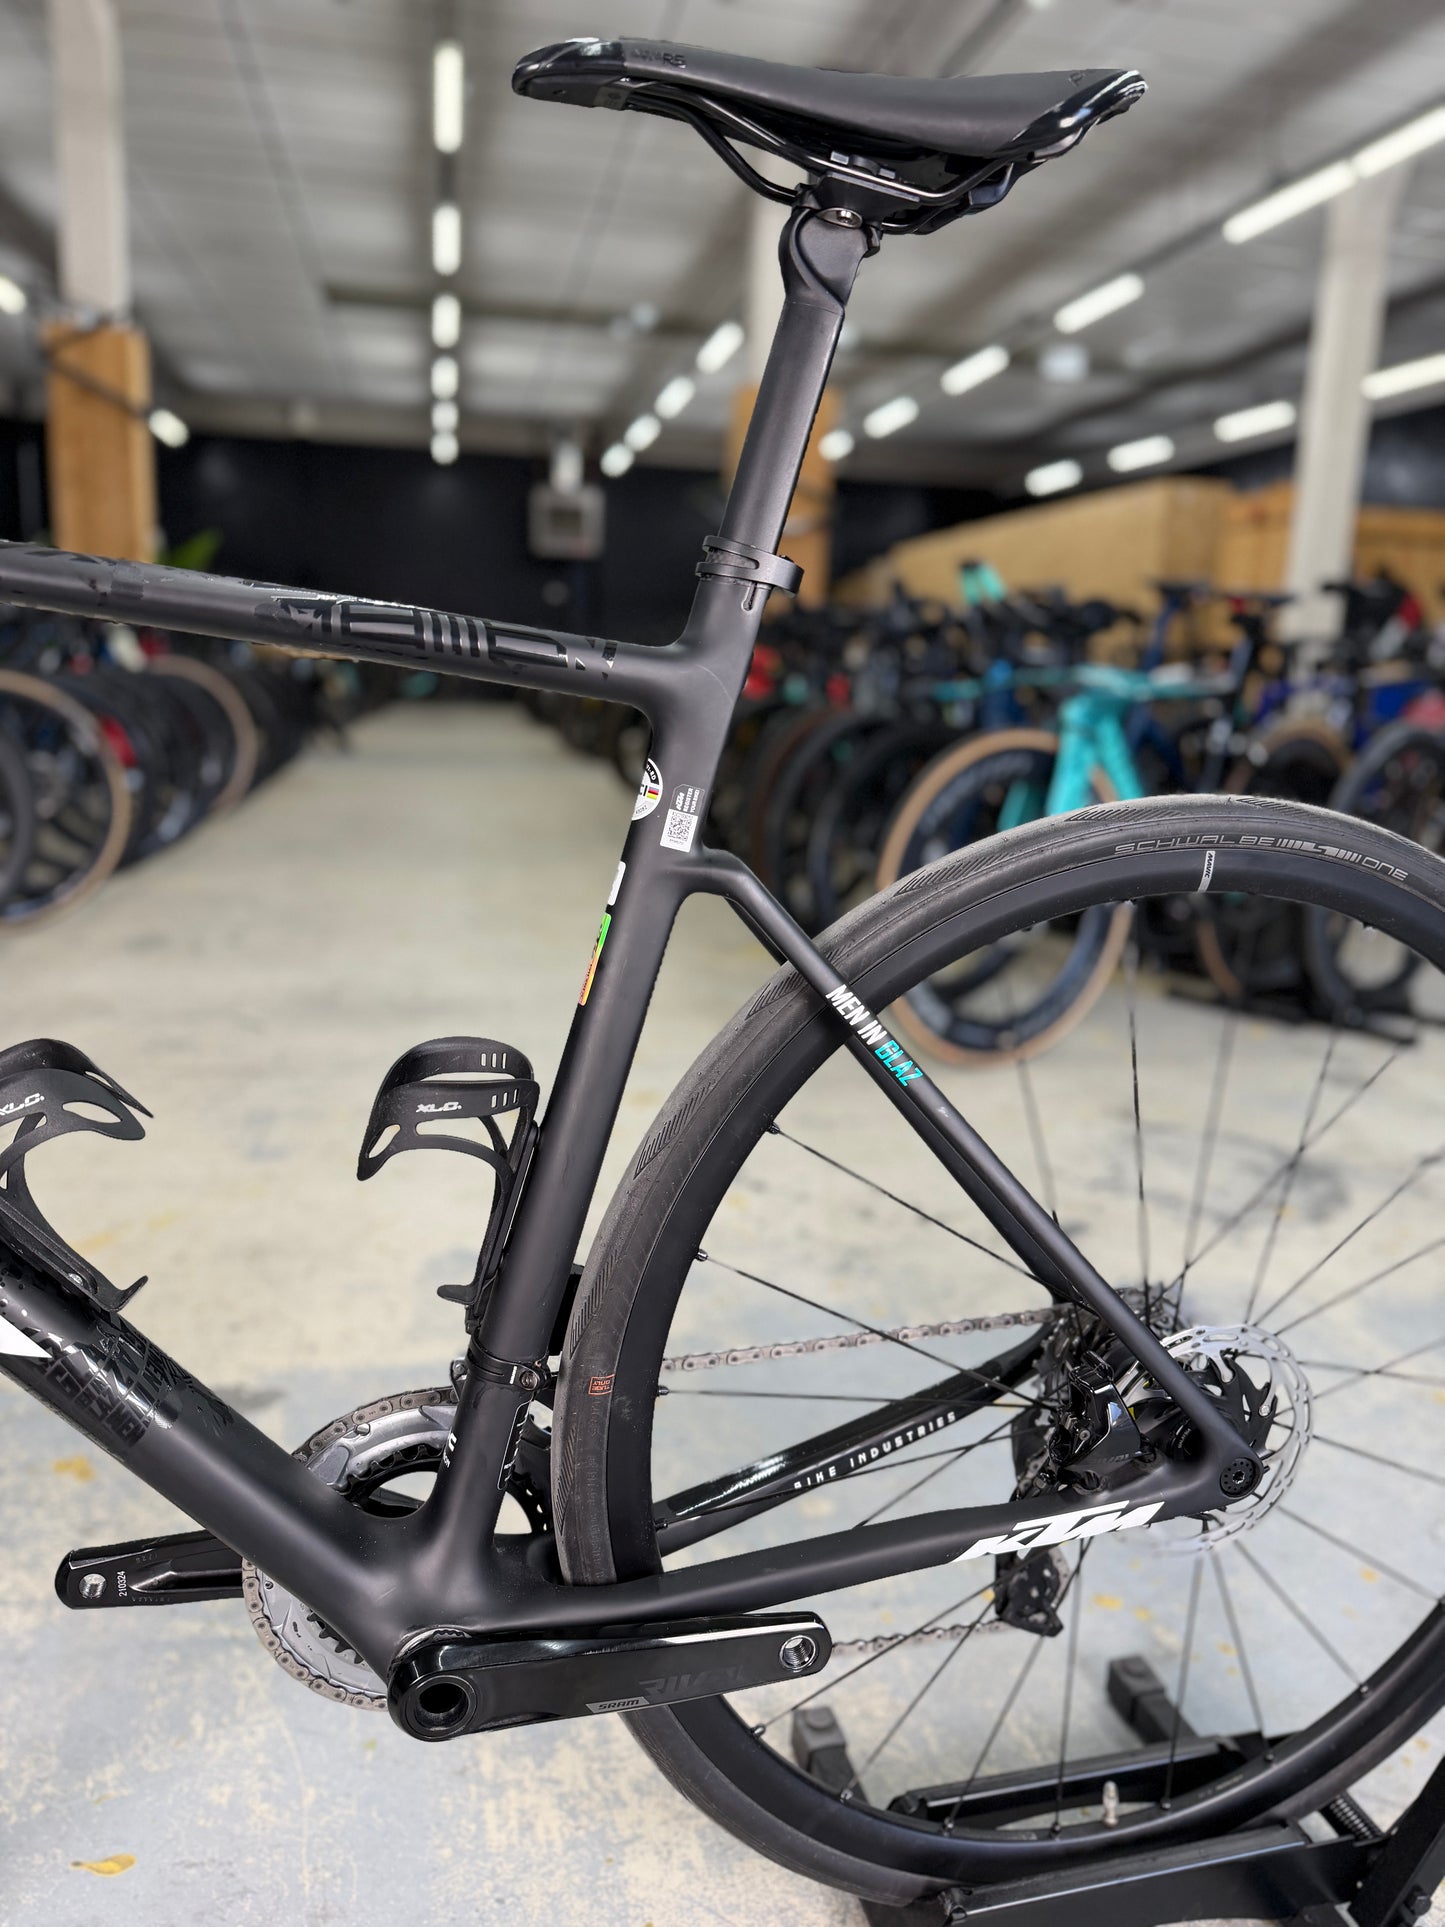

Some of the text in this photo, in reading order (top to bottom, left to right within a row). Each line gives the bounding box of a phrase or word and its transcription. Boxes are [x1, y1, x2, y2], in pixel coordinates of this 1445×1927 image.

[682, 787, 695, 813] REGISTER
[1114, 834, 1409, 882] SCHWALBE ONE
[1204, 852, 1213, 879] MAVIC
[825, 984, 924, 1087] MEN IN GLAZ
[850, 1411, 957, 1468] INDUSTRIES
[952, 1500, 1165, 1564] KTM
[116, 1570, 128, 1597] 210324
[598, 1699, 640, 1711] SRAM
